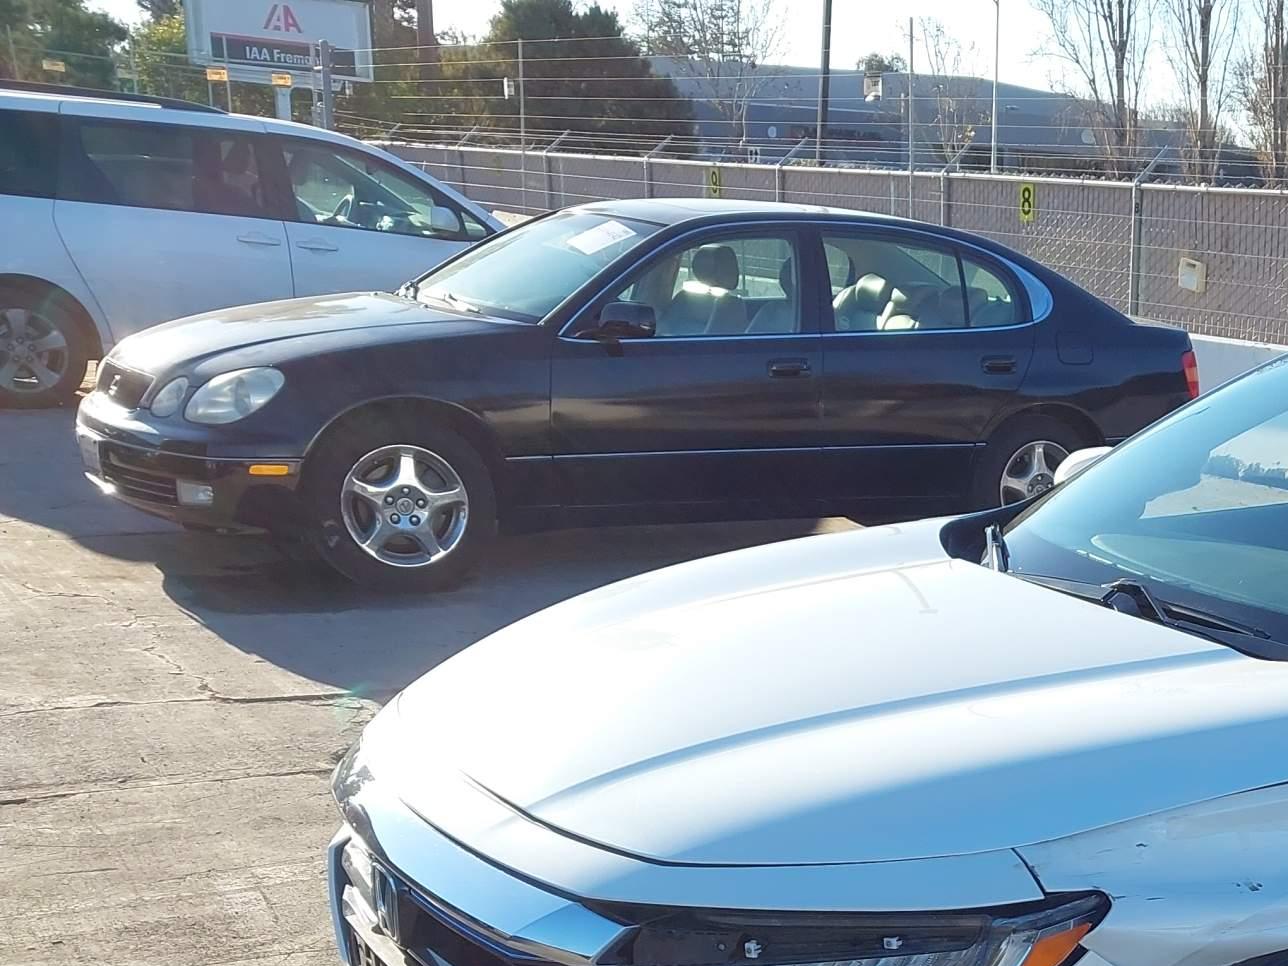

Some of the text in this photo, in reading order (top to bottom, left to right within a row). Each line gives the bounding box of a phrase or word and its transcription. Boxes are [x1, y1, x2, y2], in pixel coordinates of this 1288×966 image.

[245, 46, 320, 65] IAA Fremon
[1021, 187, 1031, 215] 8
